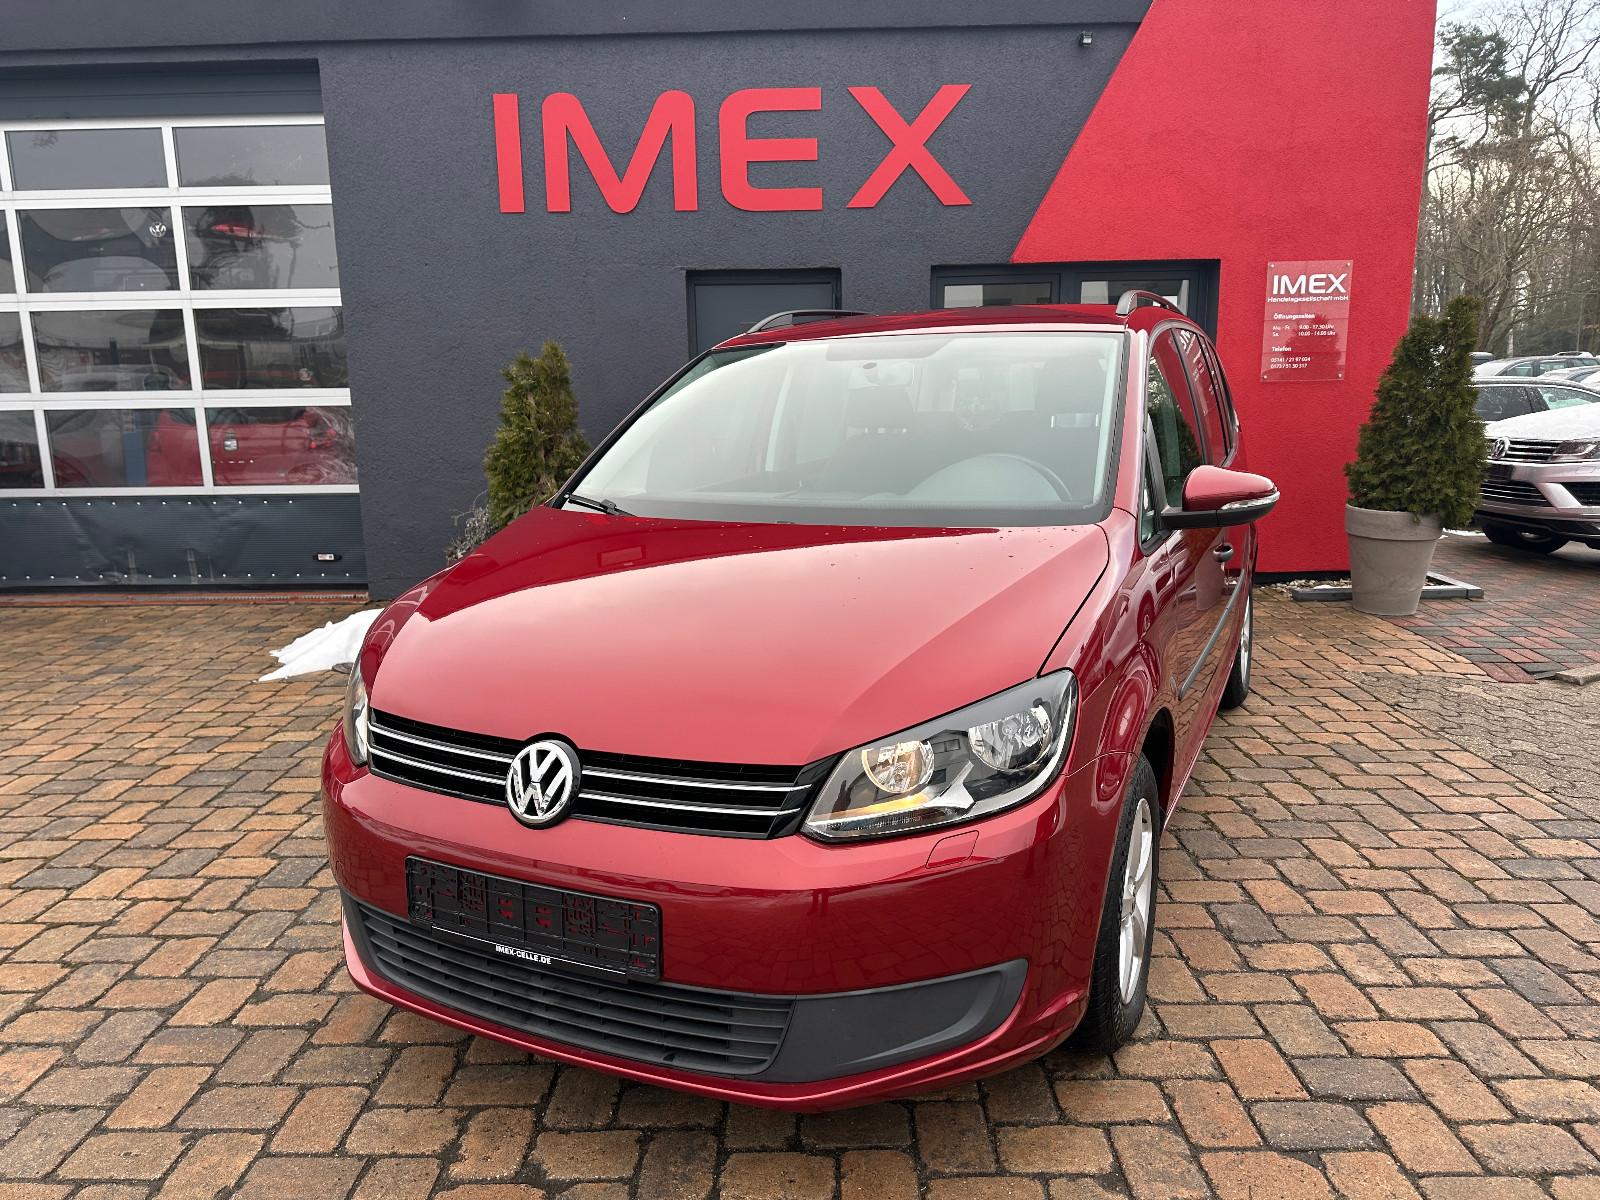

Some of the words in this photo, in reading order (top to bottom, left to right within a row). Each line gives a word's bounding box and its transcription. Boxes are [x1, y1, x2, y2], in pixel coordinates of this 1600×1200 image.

[493, 84, 972, 214] IMEX
[1272, 273, 1348, 295] IMEX
[506, 741, 574, 822] VW
[495, 944, 552, 965] IMEX-CELLE.DE
